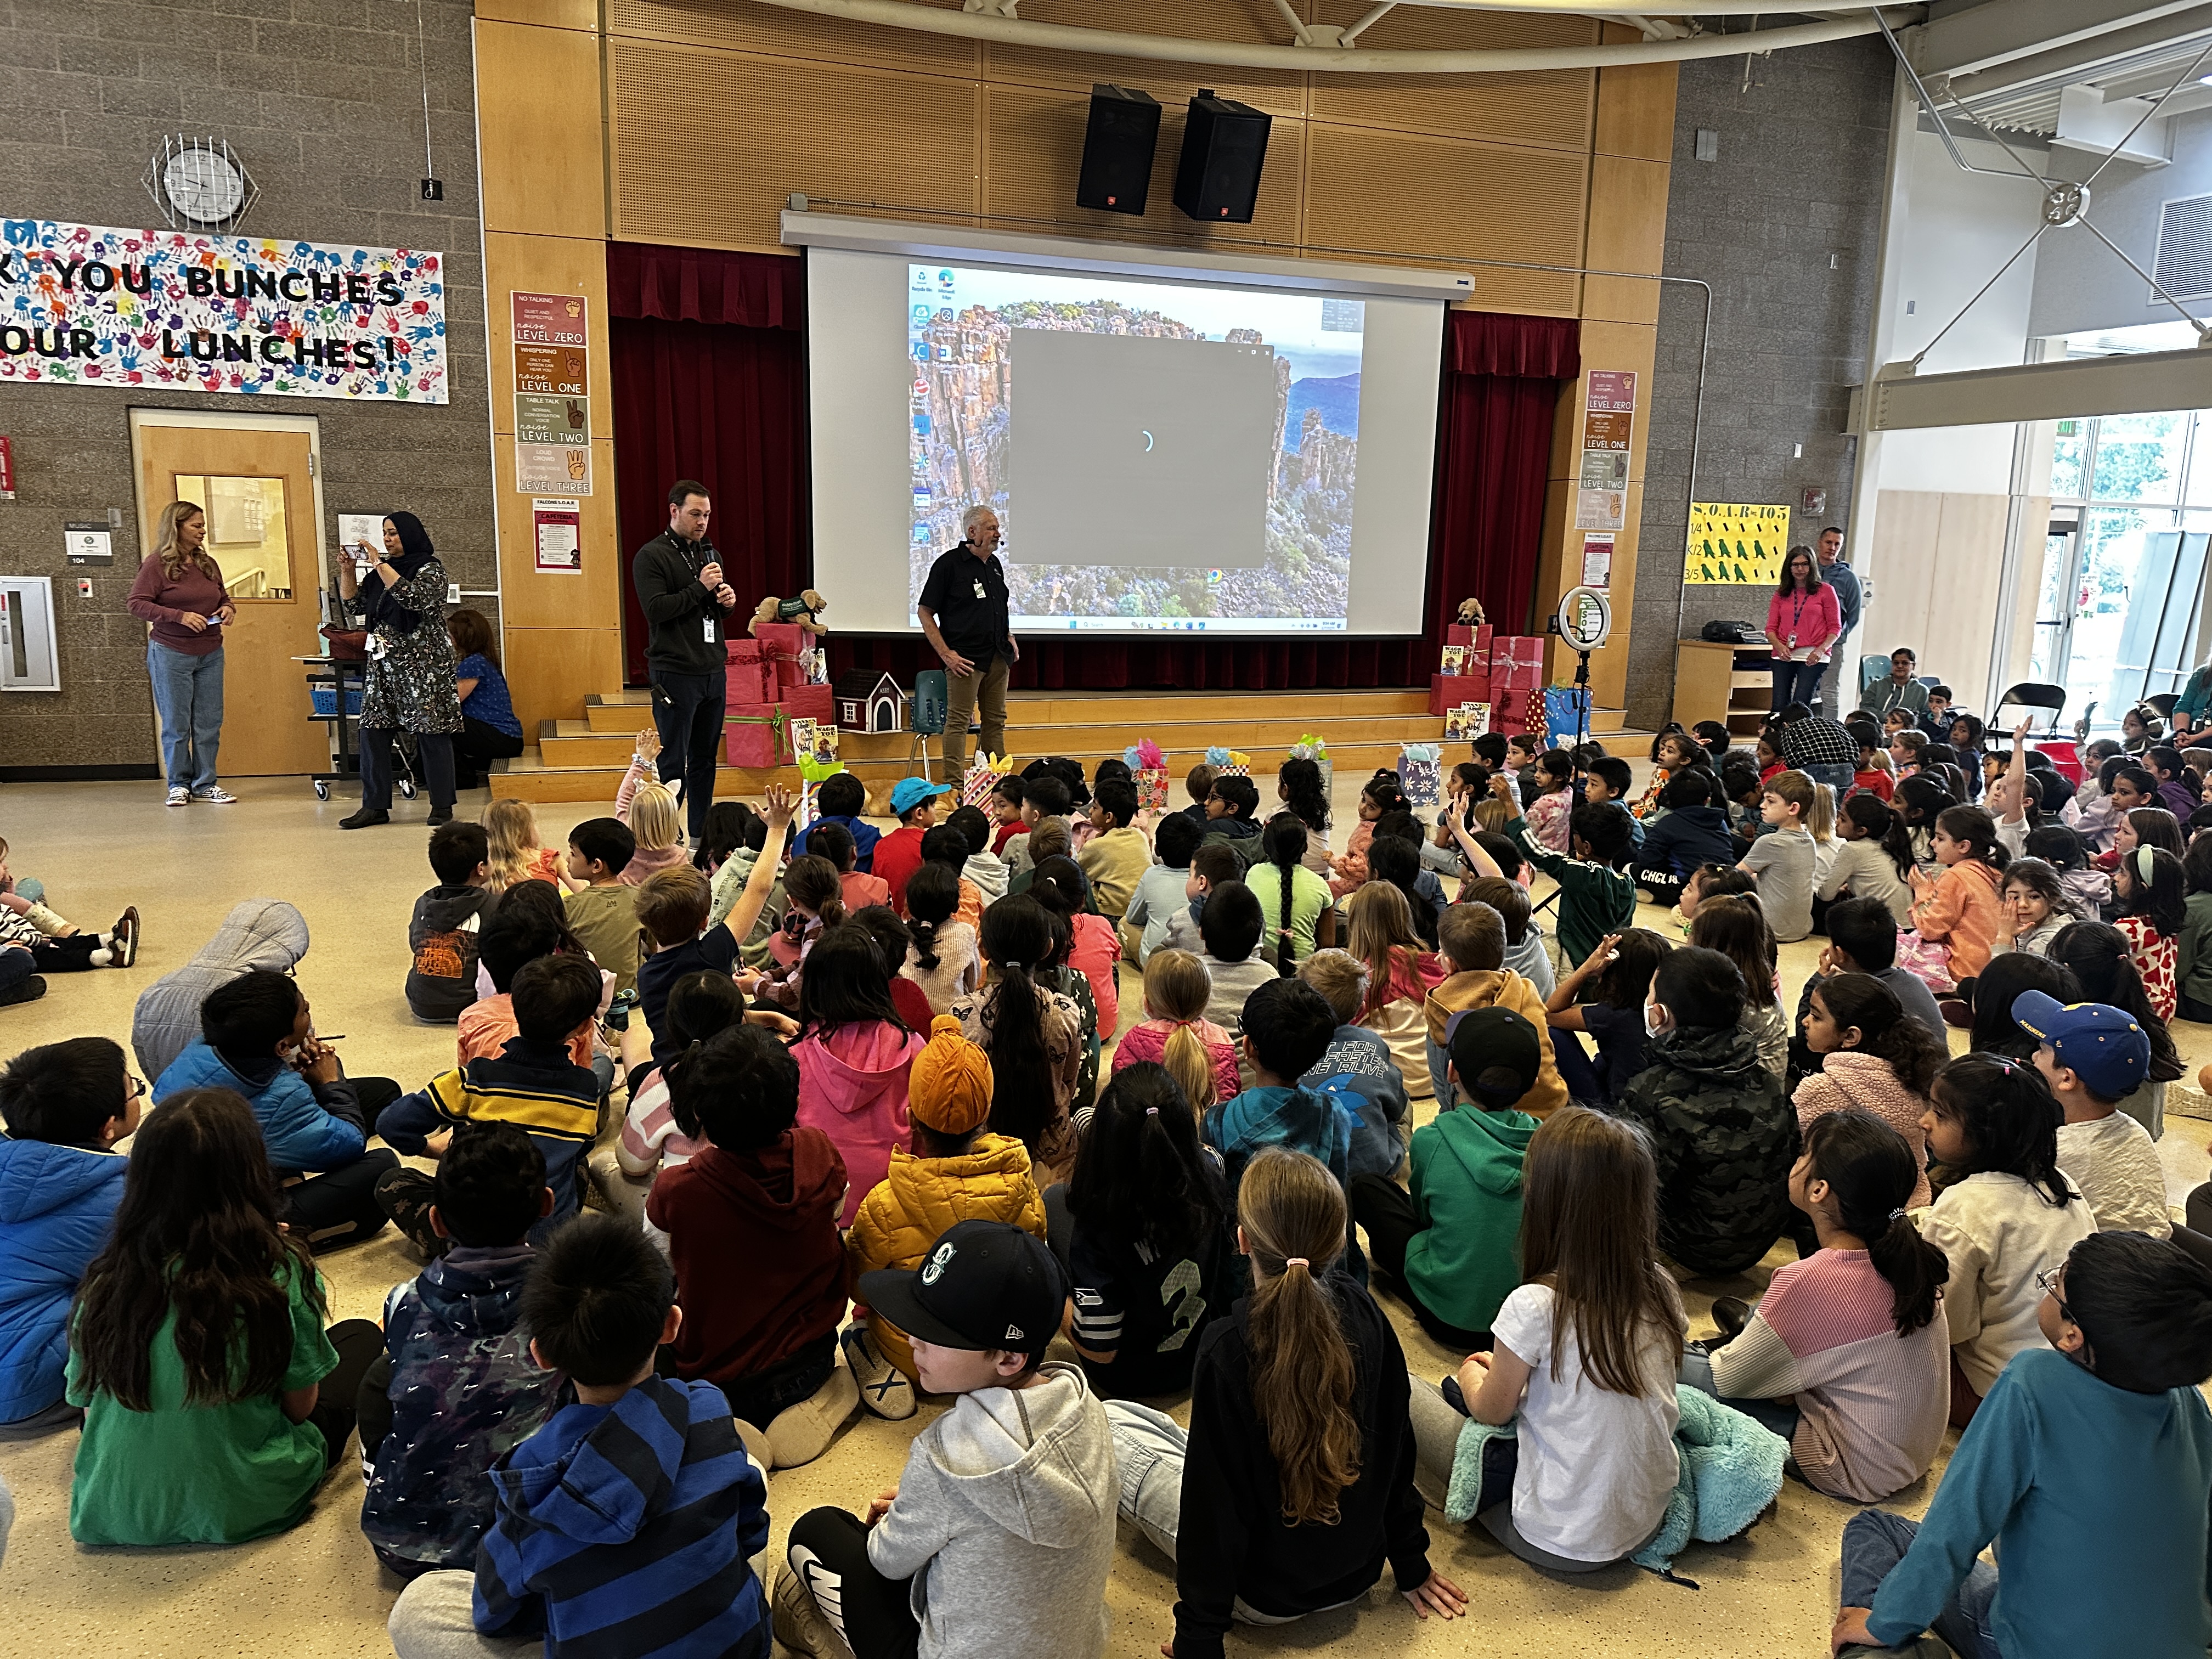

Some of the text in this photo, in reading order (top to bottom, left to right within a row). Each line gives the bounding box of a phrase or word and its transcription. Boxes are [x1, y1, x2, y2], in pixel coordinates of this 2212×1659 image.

[51, 258, 151, 294] YOU
[185, 267, 403, 307] BUNCHES
[517, 330, 583, 343] LEVEL ZERO
[163, 329, 395, 373] LUNCHES!
[522, 380, 582, 393] LEVEL ONE
[1589, 400, 1631, 409] LEVEL ZERO
[522, 431, 583, 443] LEVEL TWO
[1588, 439, 1609, 448] LEVEL
[521, 481, 590, 493] LEVEL THREE
[1584, 479, 1604, 488] LEVEL
[1758, 506, 1775, 519] TO
[1777, 507, 1787, 520] 5
[1577, 519, 1622, 528] LEVEL THREE
[1691, 523, 1702, 534] 1/4
[1687, 543, 1702, 556] K/2
[1641, 869, 1667, 884] CHCL
[2019, 1019, 2046, 1039] MARINERS
[1342, 1041, 1377, 1052] FOR
[1337, 1062, 1386, 1079] ALIVE
